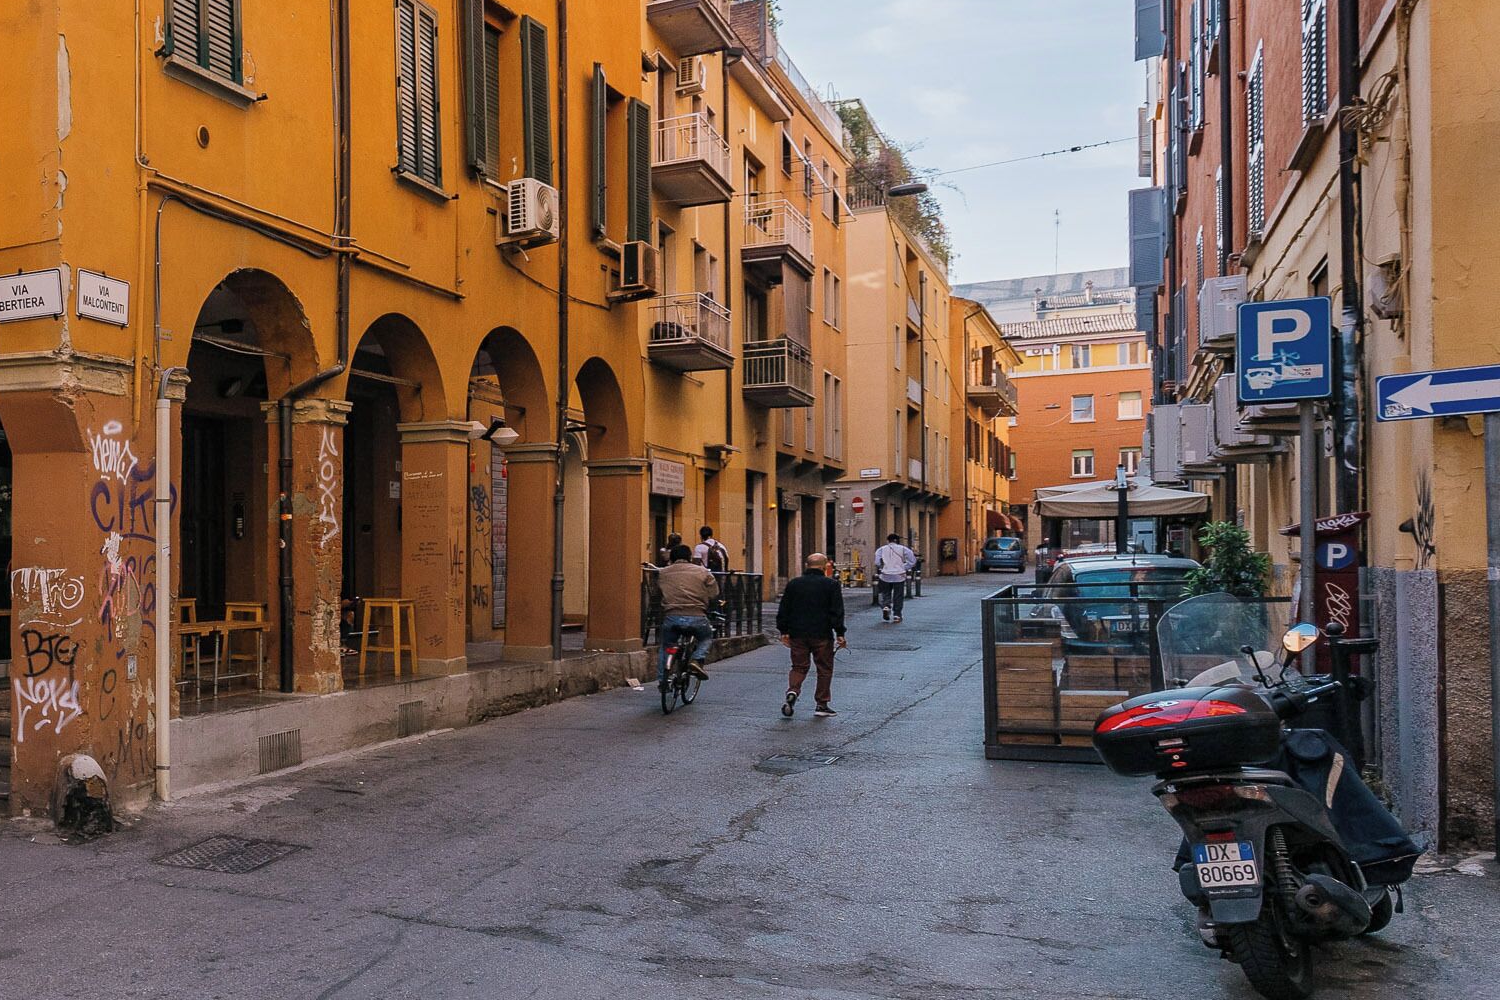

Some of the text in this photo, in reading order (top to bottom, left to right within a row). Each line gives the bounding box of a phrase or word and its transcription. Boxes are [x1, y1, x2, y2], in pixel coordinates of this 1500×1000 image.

[11, 284, 29, 297] VIA
[99, 284, 110, 298] VIA
[83, 295, 125, 315] MALCONTENTI
[1257, 309, 1311, 361] P
[1326, 543, 1348, 567] P
[1207, 844, 1230, 861] DX
[1200, 864, 1255, 883] 80669
